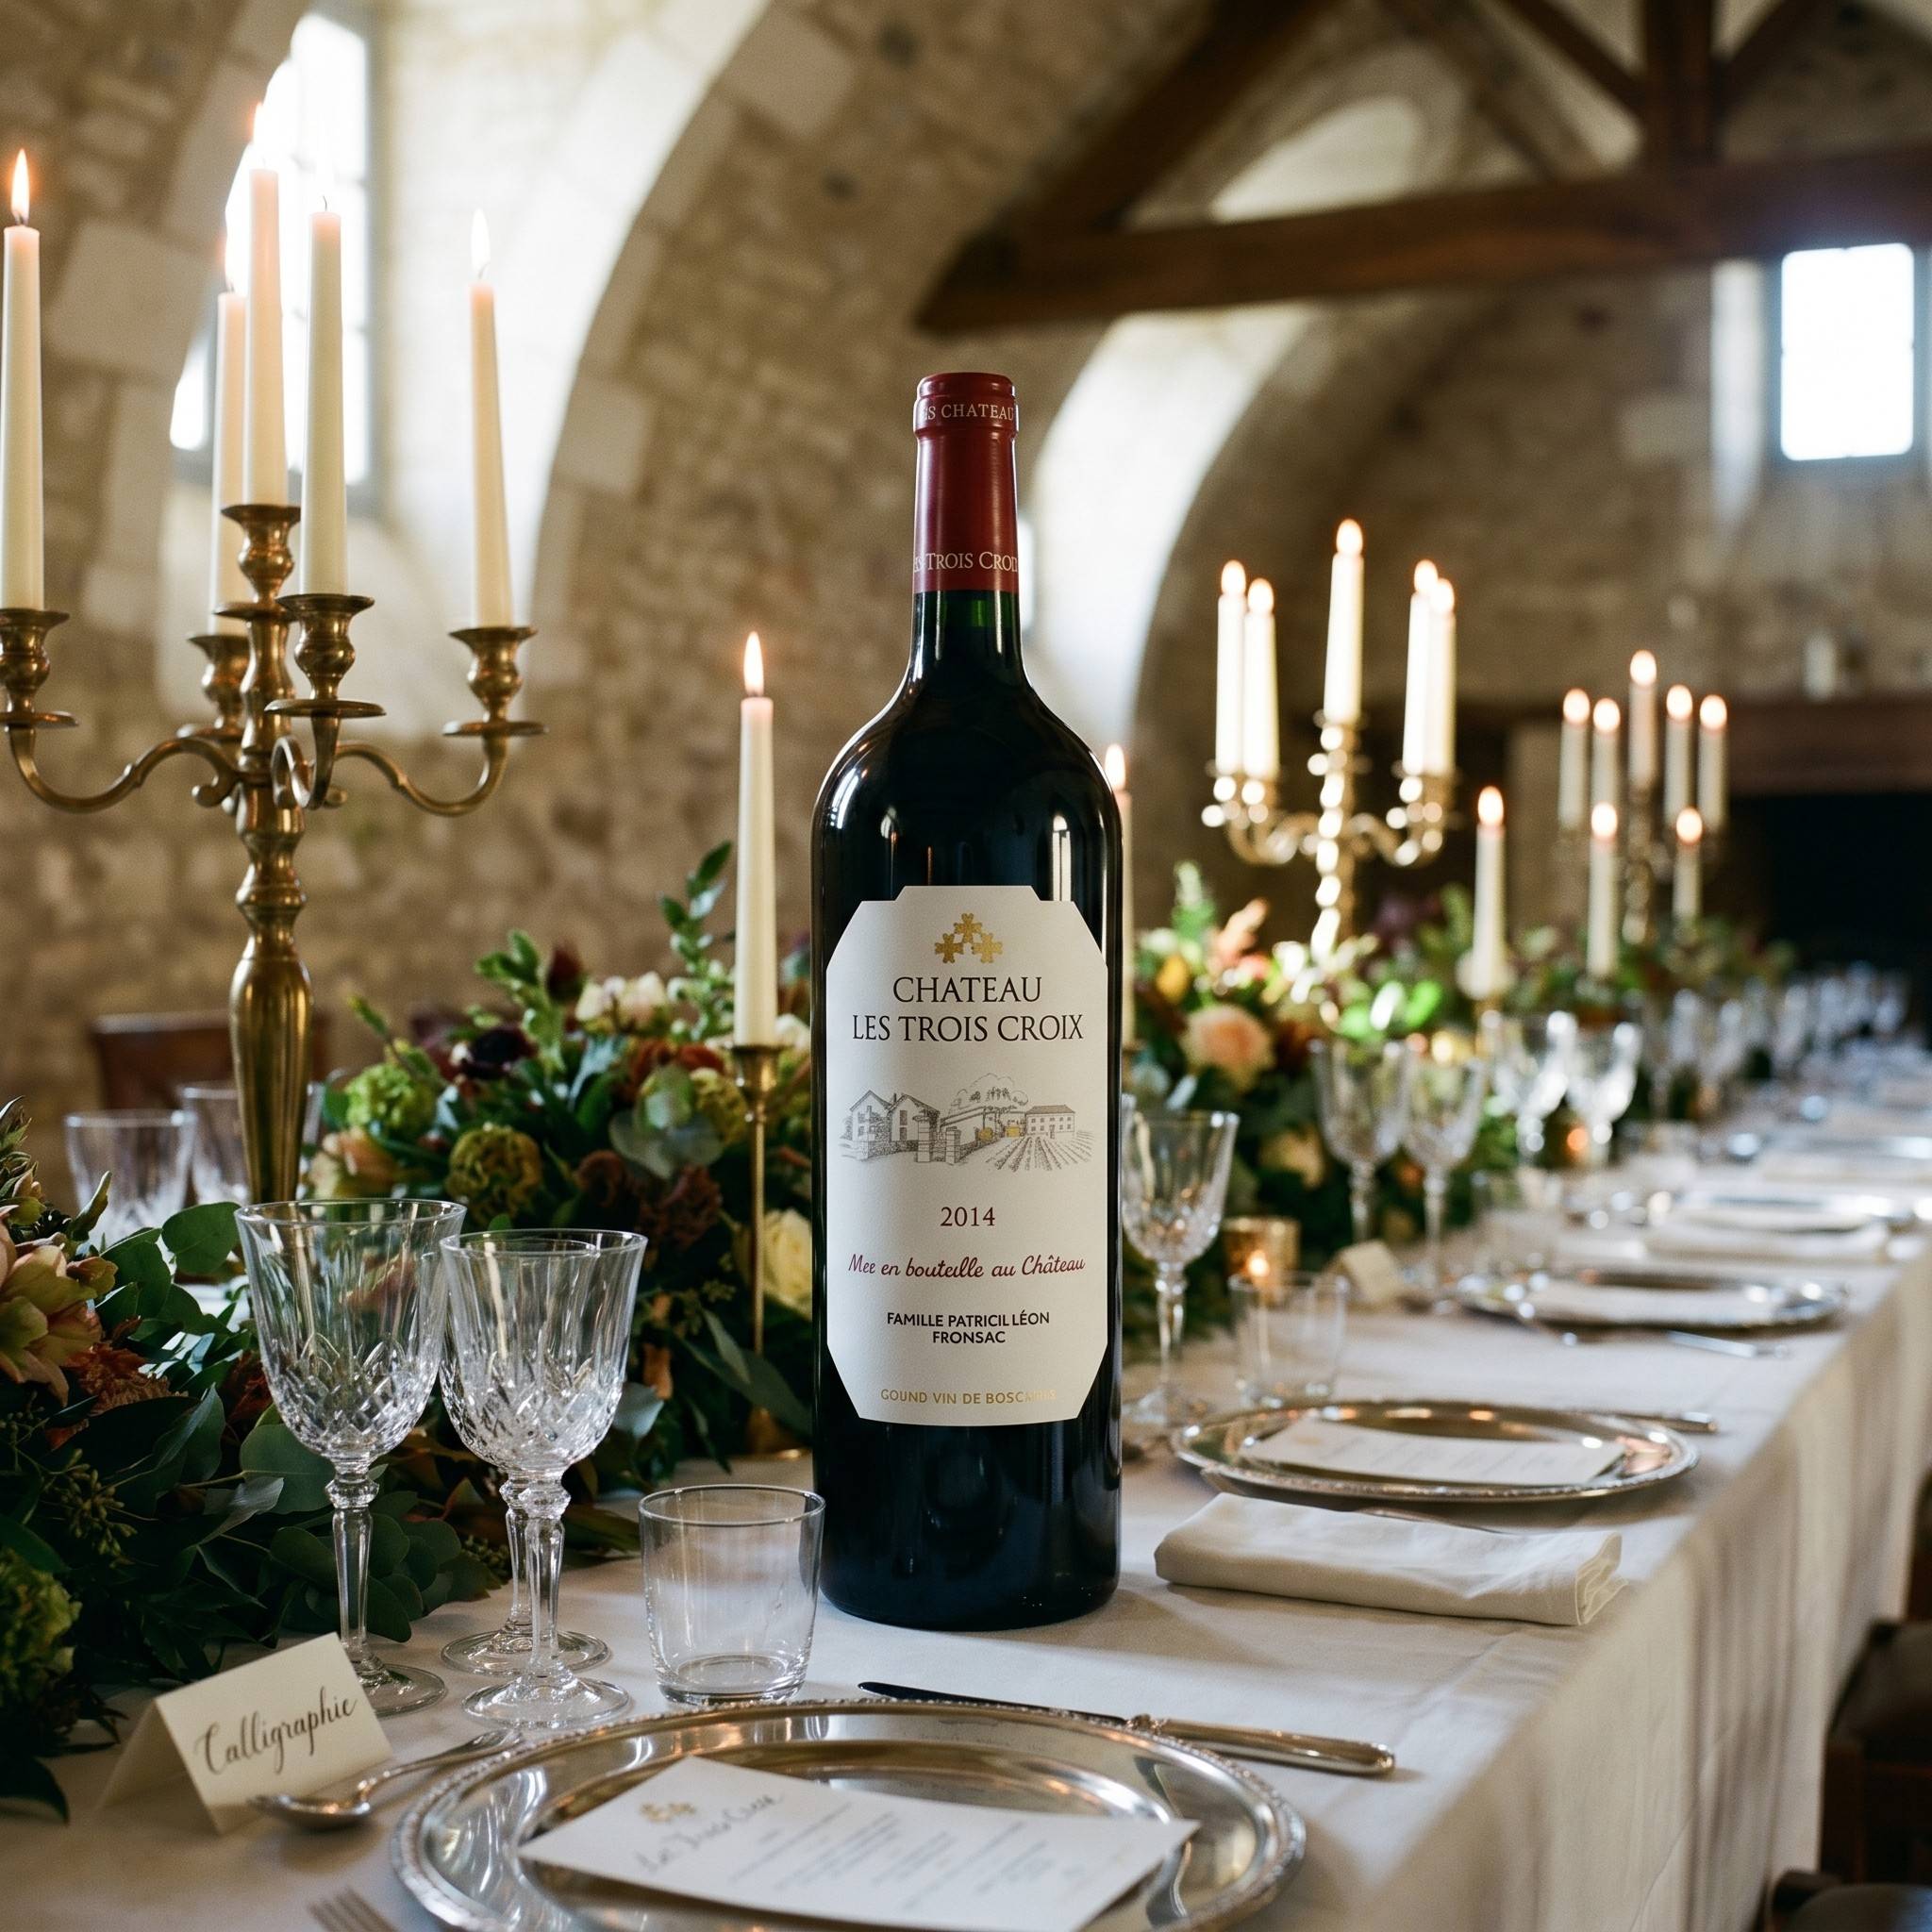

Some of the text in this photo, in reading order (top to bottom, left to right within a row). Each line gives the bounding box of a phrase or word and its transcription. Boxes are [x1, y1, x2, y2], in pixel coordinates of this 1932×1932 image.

[941, 404, 1014, 421] CHATEAU
[925, 553, 974, 570] TROIS
[893, 976, 1041, 1003] CHATEAU
[853, 1015, 1083, 1041] LES TROIS CROIX
[941, 1207, 995, 1226] 2014
[881, 1264, 901, 1275] en
[991, 1263, 1016, 1277] au
[1022, 1255, 1086, 1275] Château
[887, 1312, 943, 1327] FAMILLE
[1012, 1309, 1050, 1326] LÉON
[933, 1331, 1006, 1344] FRONSAC
[880, 1389, 927, 1404] GOUND
[933, 1392, 957, 1405] VIN
[963, 1393, 981, 1405] DE
[194, 1686, 358, 1775] Calligraphie
